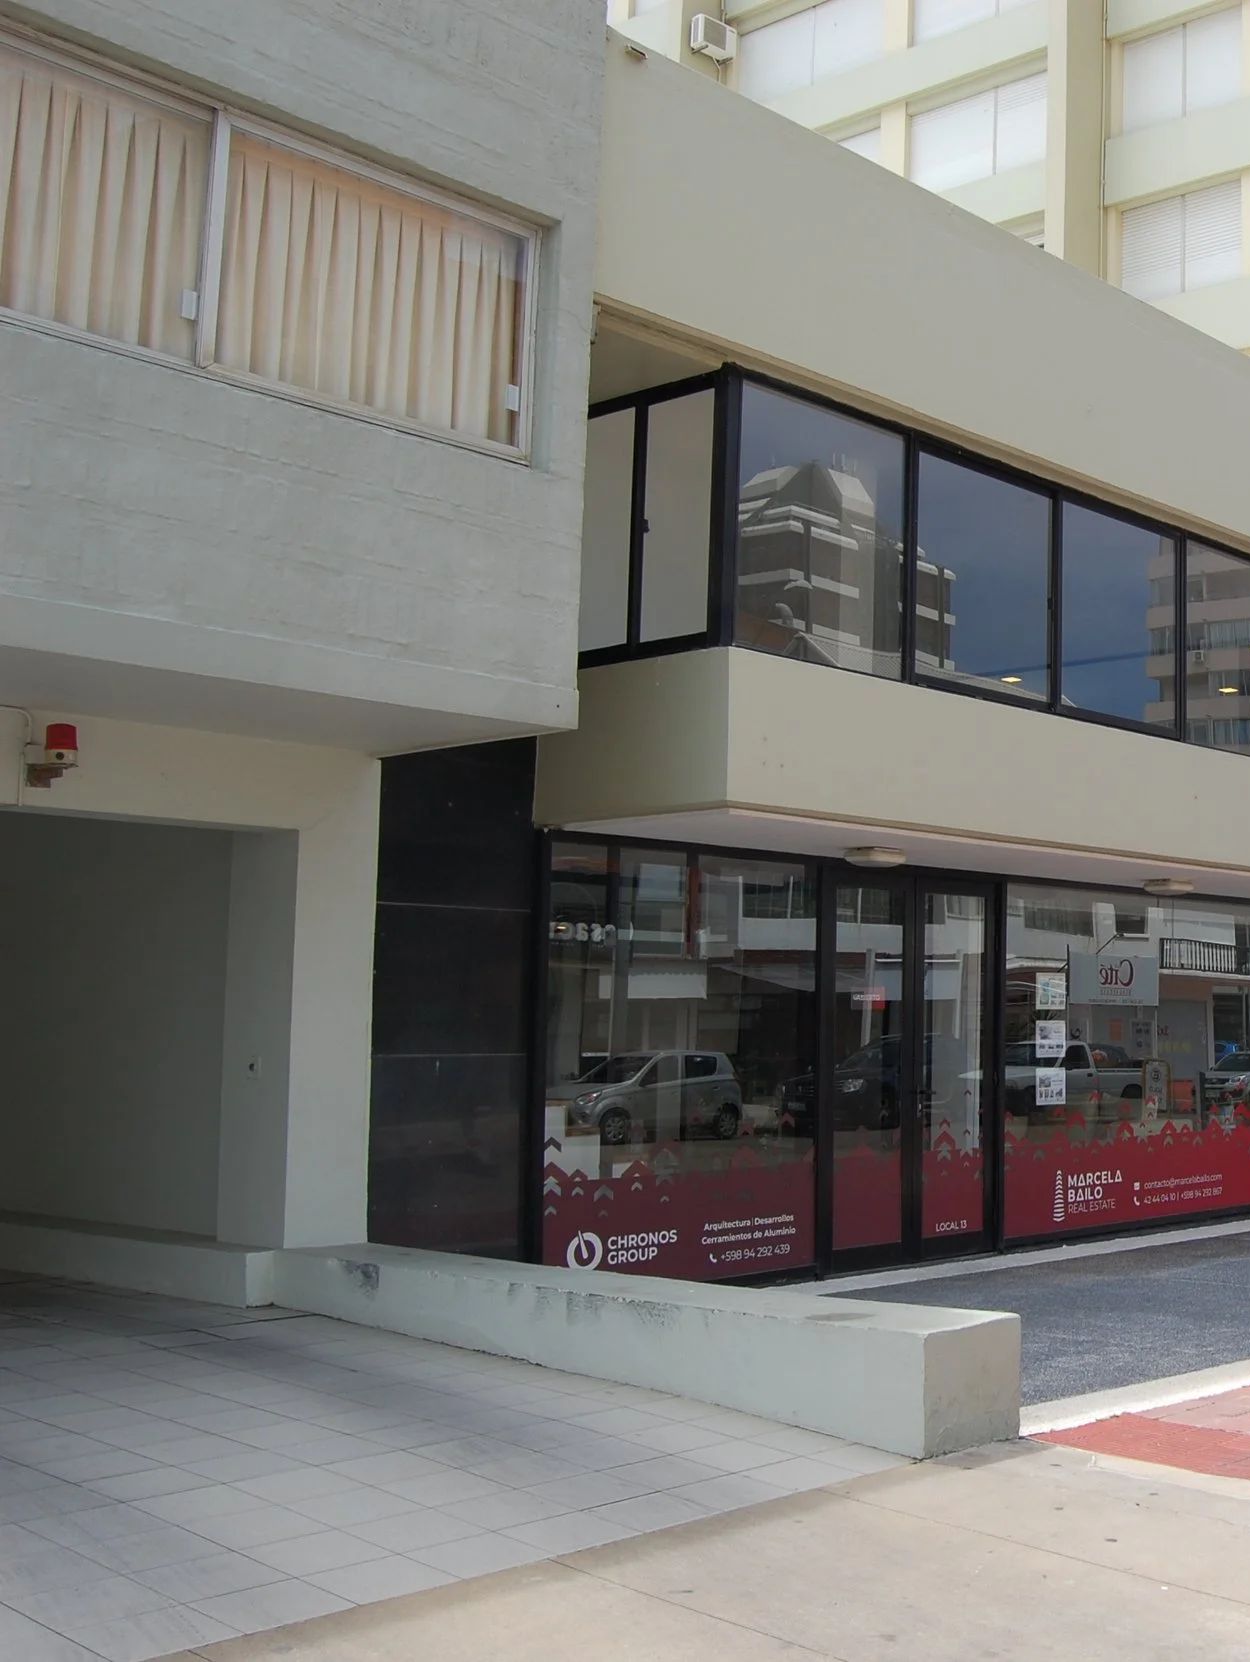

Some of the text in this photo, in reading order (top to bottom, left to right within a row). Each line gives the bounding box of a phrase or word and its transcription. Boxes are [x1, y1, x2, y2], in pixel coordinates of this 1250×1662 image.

[1068, 1169, 1122, 1187] MARCELA
[1068, 1186, 1103, 1202] BAILO
[1068, 1198, 1116, 1214] REAL ESTATE
[703, 1214, 794, 1232] Arquitectura Desarrollos
[935, 1220, 967, 1232] LOCAL 13
[607, 1229, 678, 1250] CHRONOS
[701, 1225, 796, 1245] Cerramientos de Aluminio
[607, 1246, 658, 1265] GROUP
[743, 1248, 755, 1259] 94
[756, 1245, 773, 1258] 292
[774, 1243, 791, 1255] 439
